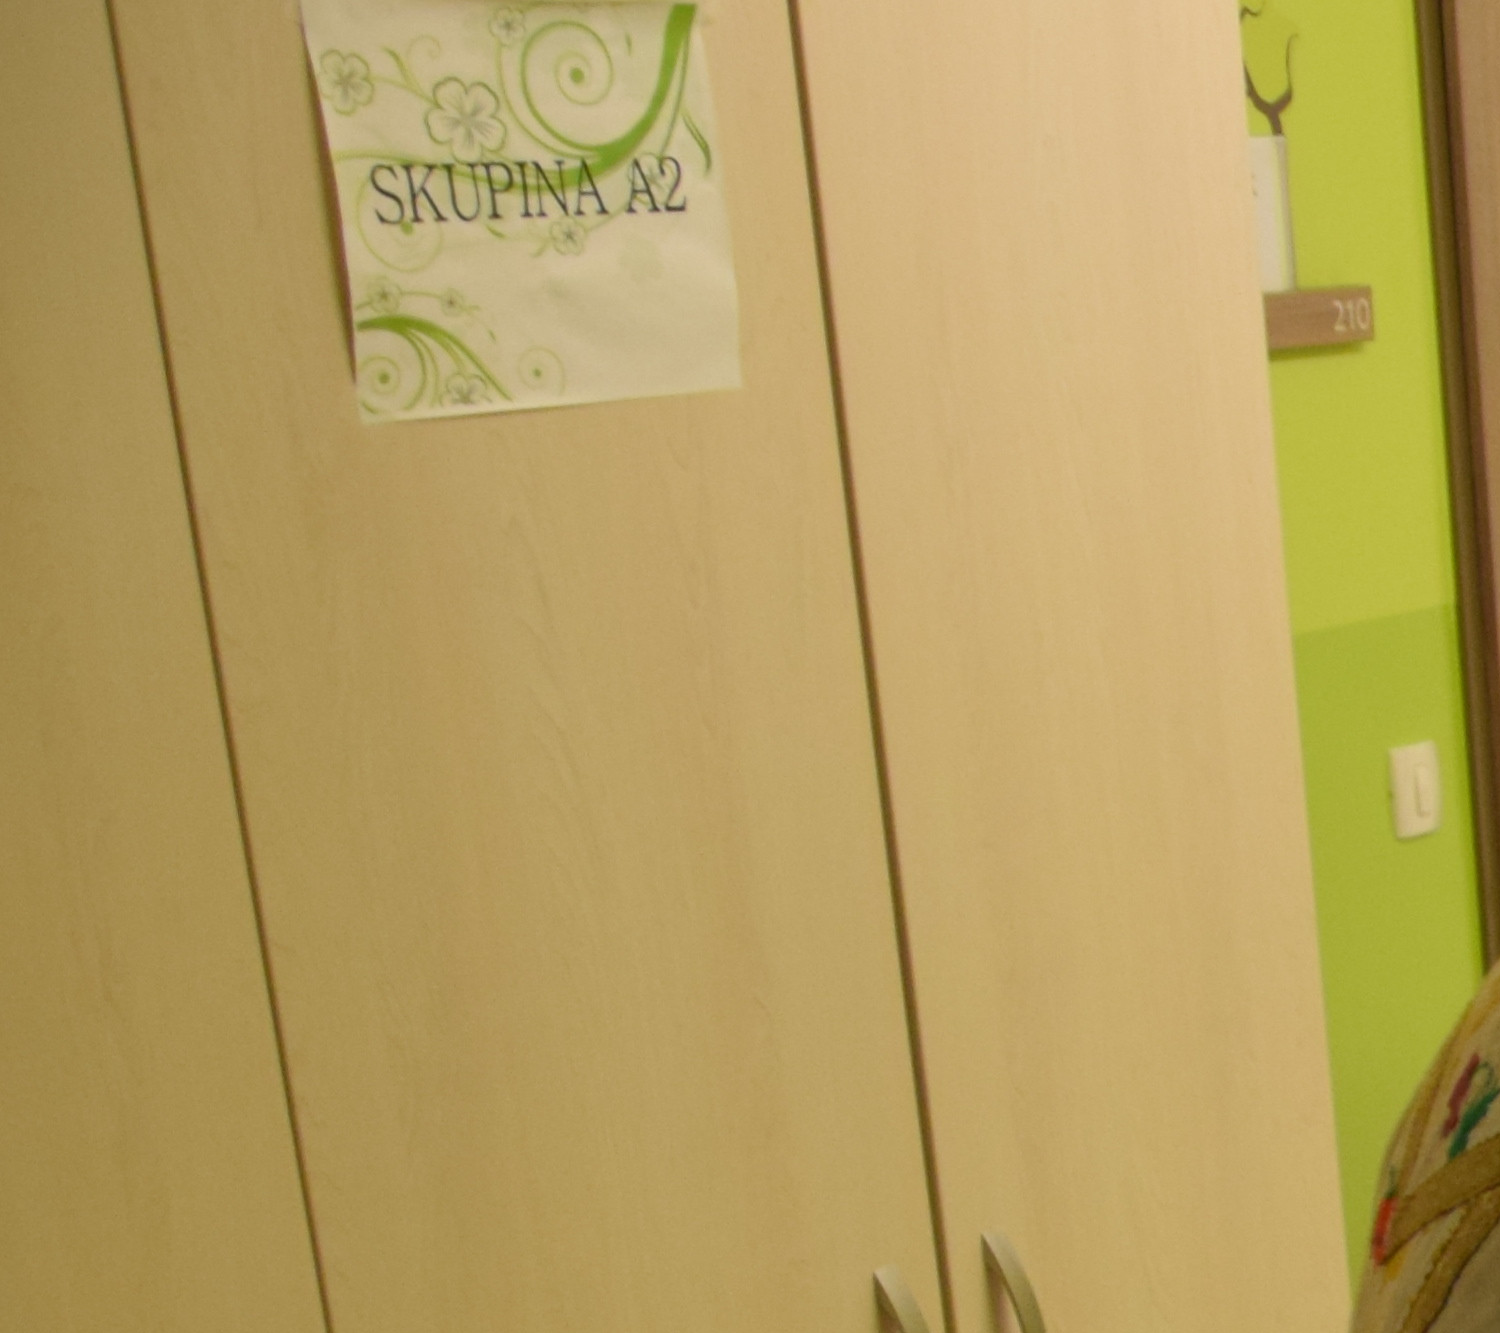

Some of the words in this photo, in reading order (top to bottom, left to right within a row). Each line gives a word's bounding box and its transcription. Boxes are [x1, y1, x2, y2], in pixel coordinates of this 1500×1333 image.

[369, 158, 608, 225] SKUPINA
[627, 156, 687, 214] A2
[1332, 298, 1371, 332] 210
